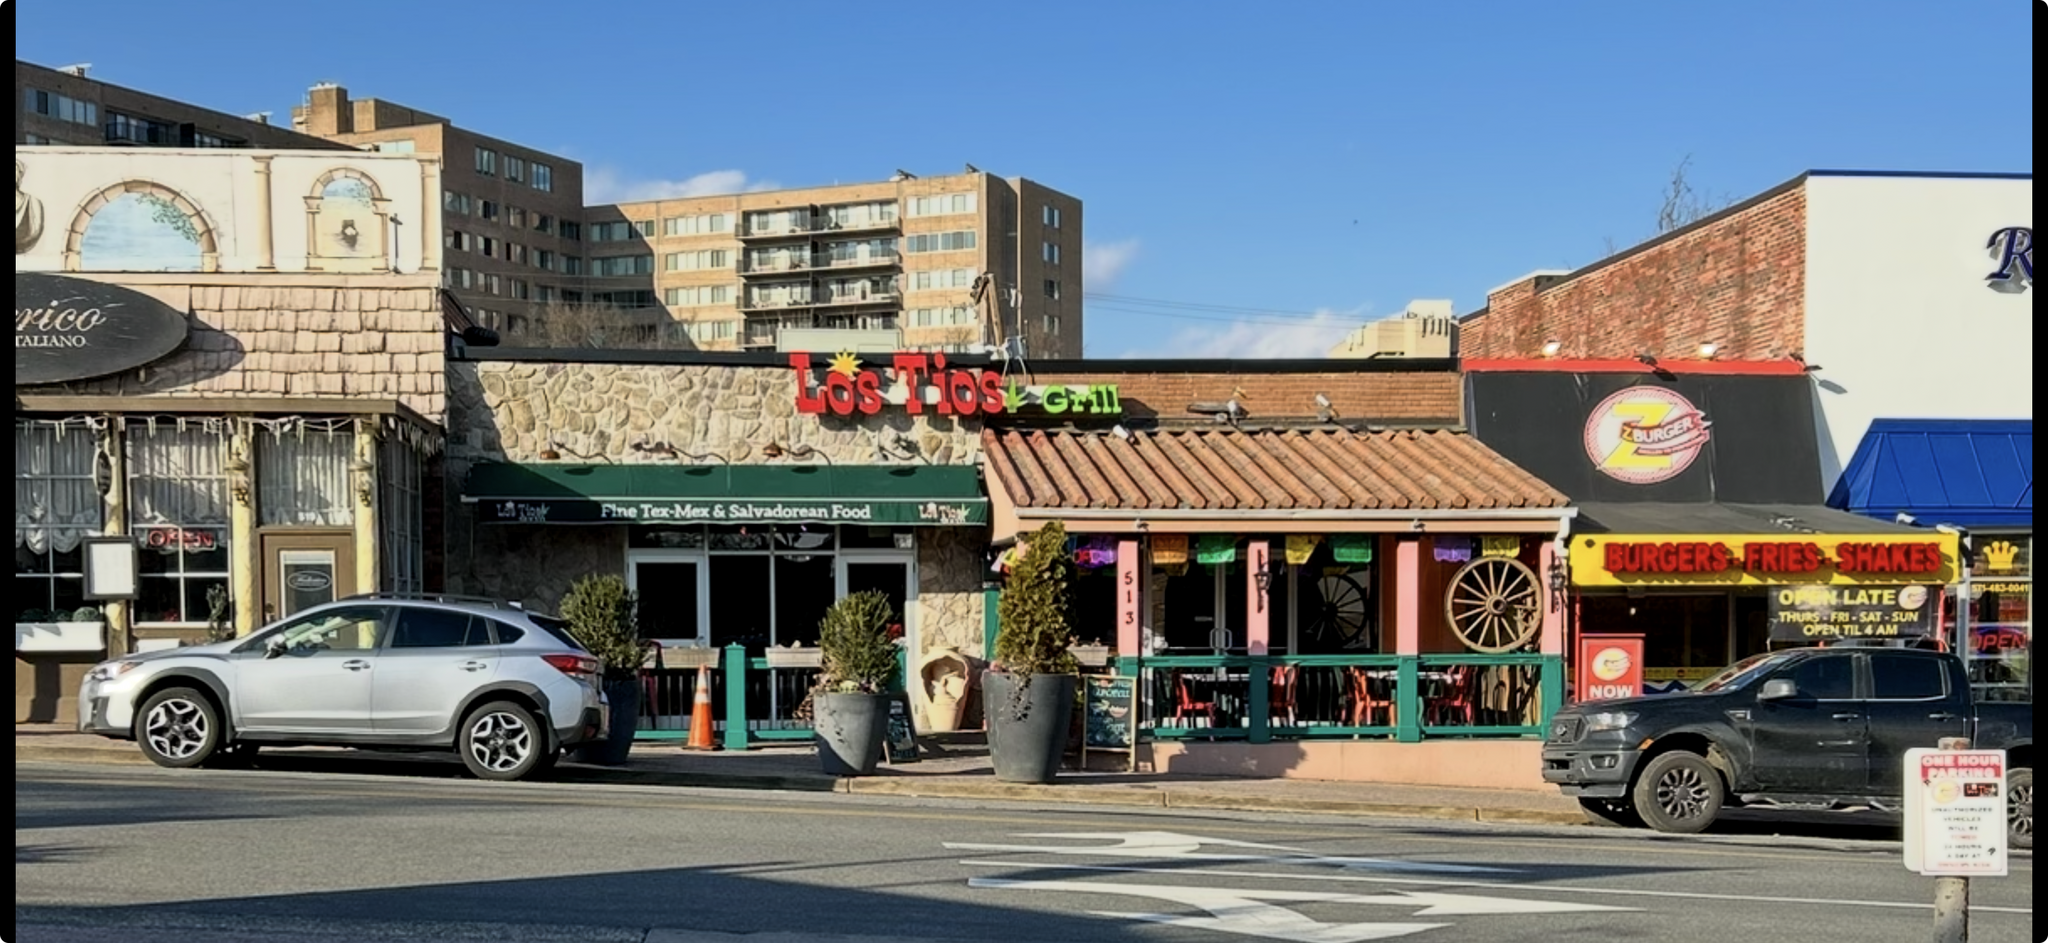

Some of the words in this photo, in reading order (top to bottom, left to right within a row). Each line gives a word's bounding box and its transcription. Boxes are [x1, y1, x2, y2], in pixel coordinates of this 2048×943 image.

[16, 299, 107, 331] rico
[789, 352, 881, 415] Los
[893, 353, 1005, 415] Tios
[1042, 384, 1122, 414] Grill
[601, 504, 637, 519] Fine
[641, 504, 709, 519] Tex-Mex
[713, 504, 725, 519] &
[729, 504, 826, 519] Salvadorean
[831, 504, 871, 519] Food
[149, 530, 214, 547] OPEN
[1605, 542, 1728, 573] BURGERS
[1743, 542, 1821, 573] FRIES
[1835, 542, 1942, 573] SHAKES
[1779, 590, 1837, 605] OPEN
[1843, 589, 1896, 605] LATE
[1779, 611, 1819, 623] THURS
[1831, 611, 1849, 622] FRI
[1859, 611, 1882, 623] SAT
[1891, 611, 1919, 622] SUN
[1803, 624, 1840, 636] OPEN
[1844, 625, 1862, 635] TIL
[1864, 625, 1873, 635] 4
[1875, 625, 1898, 635] AM
[1589, 685, 1633, 698] NOW
[1922, 755, 1954, 767] ONE
[1958, 755, 2001, 767] HOUR
[1928, 768, 1995, 778] PARKING
